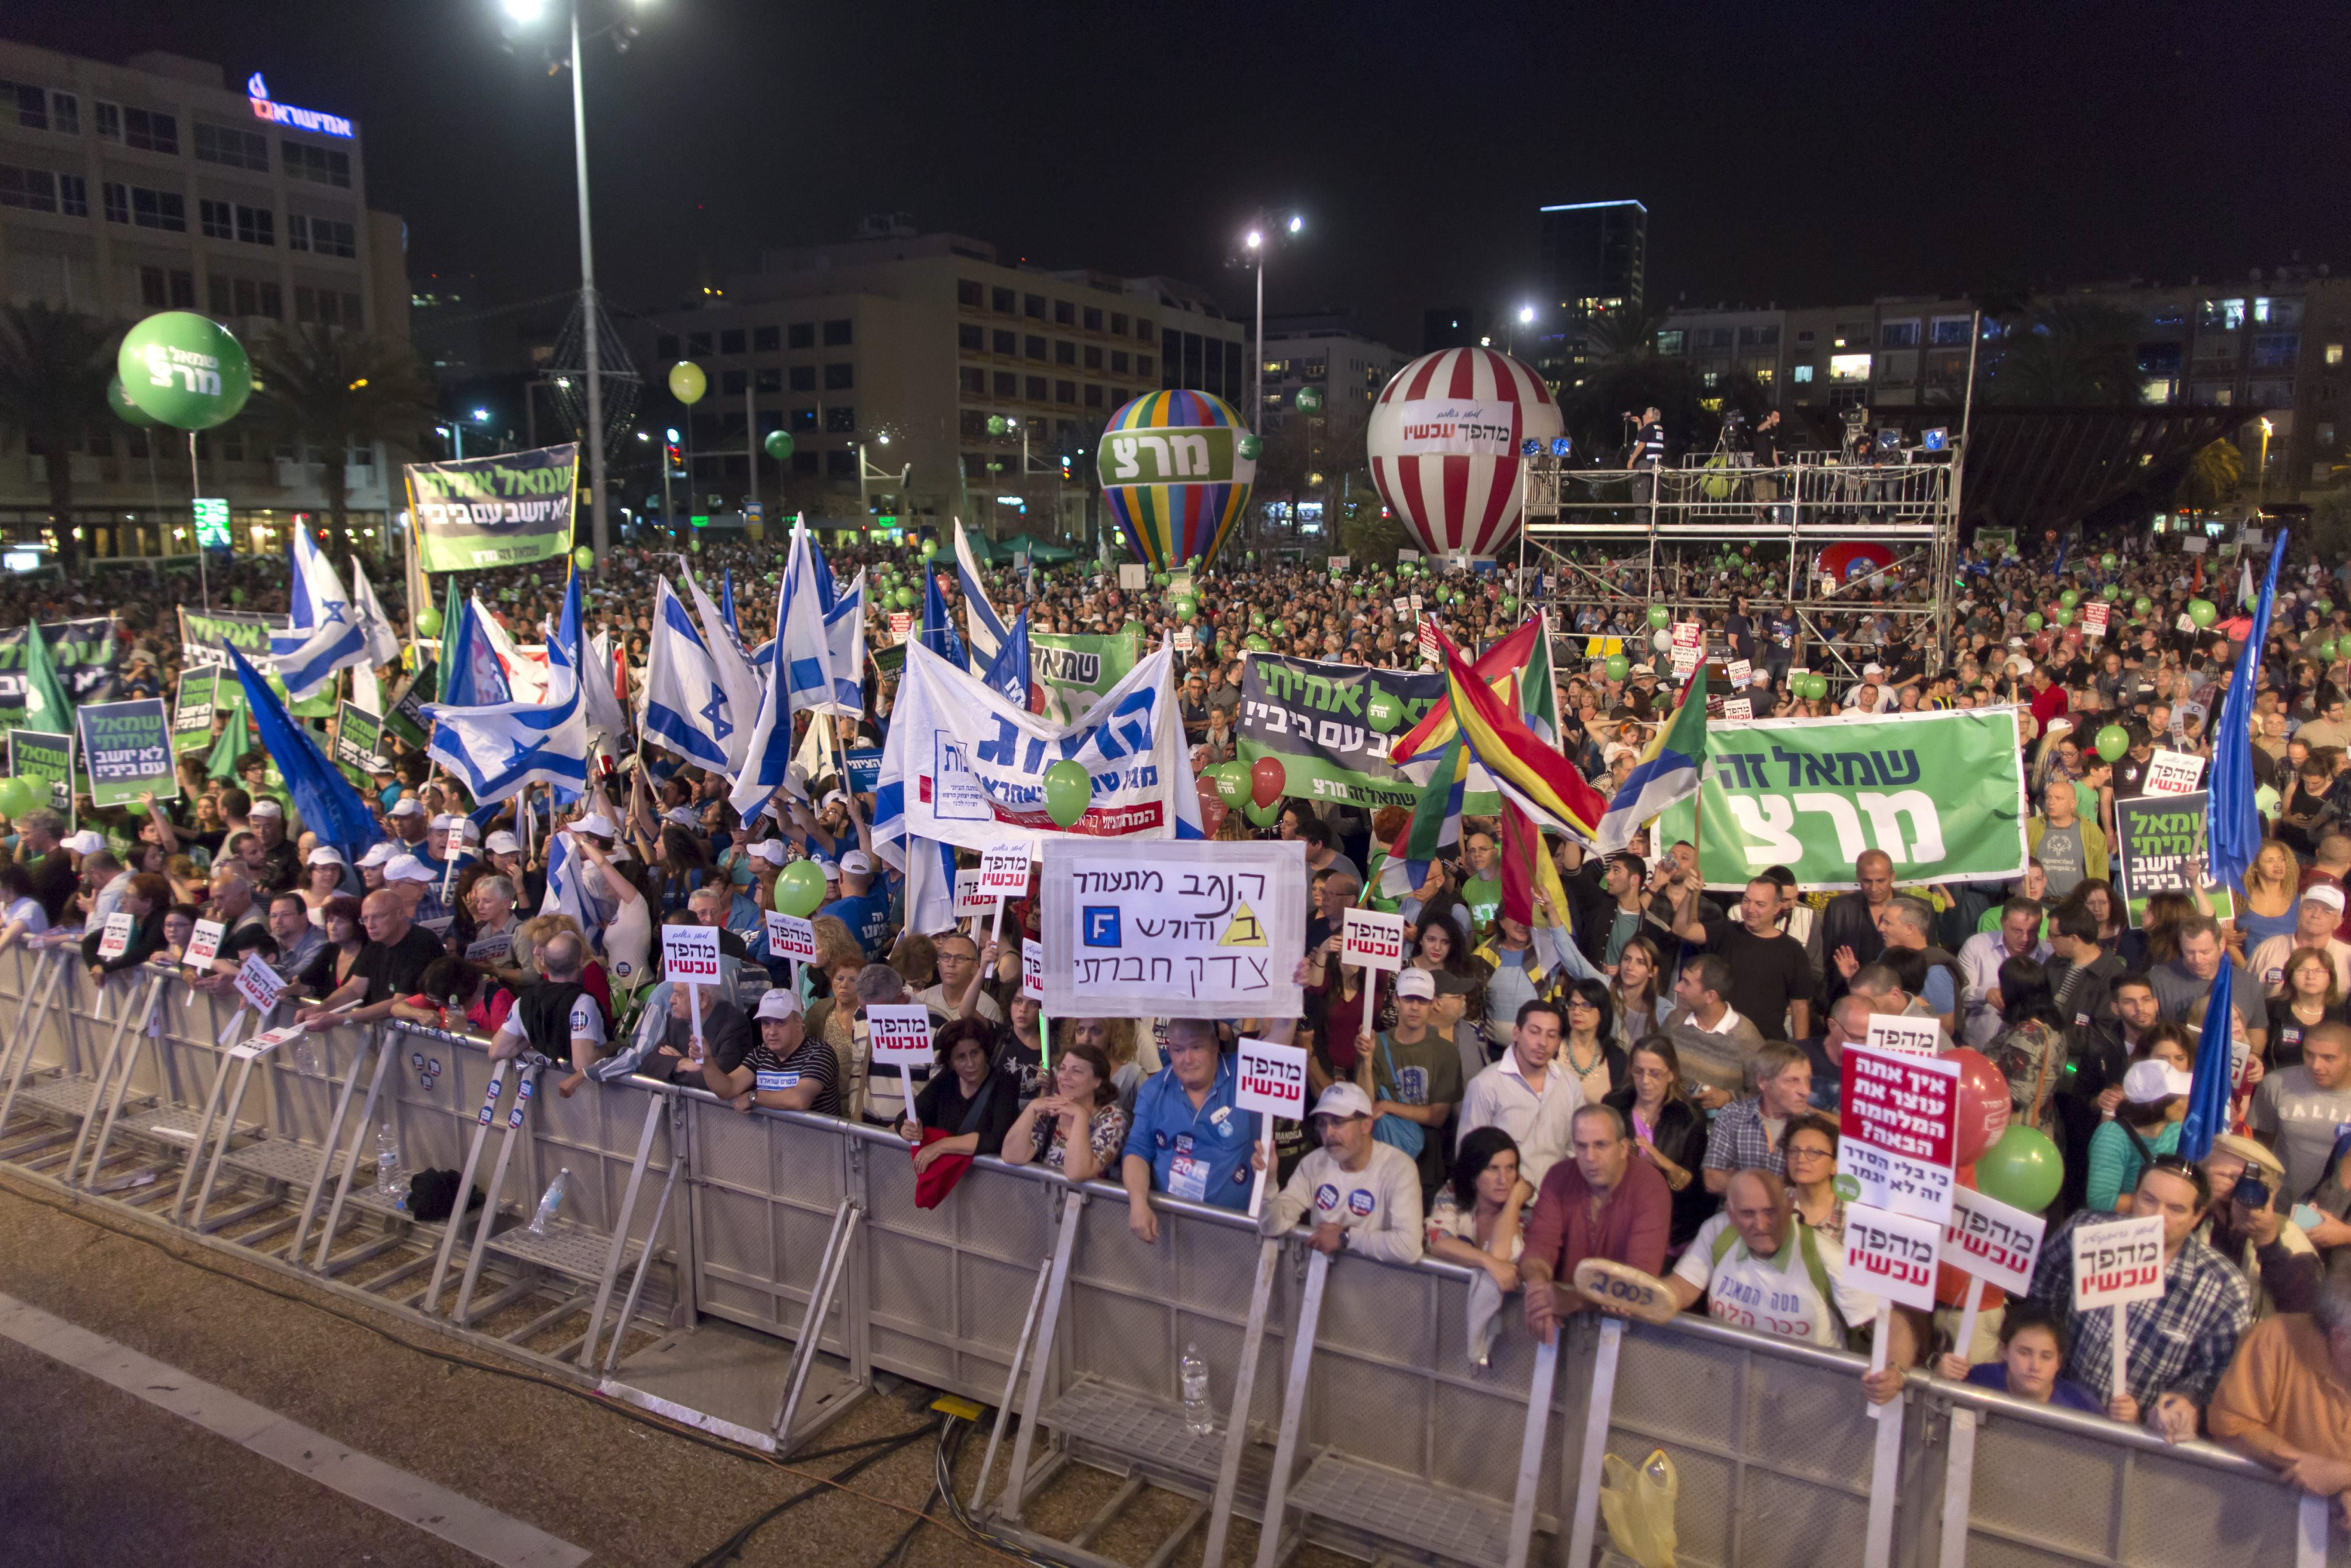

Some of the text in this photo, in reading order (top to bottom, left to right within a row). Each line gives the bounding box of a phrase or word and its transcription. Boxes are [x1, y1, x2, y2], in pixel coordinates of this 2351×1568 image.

[1404, 423, 1510, 442] מהפך עכשיו
[1112, 434, 1210, 478] מרצ
[494, 464, 573, 496] שמאל
[470, 502, 504, 525] עם
[505, 501, 550, 522] יושב
[1257, 661, 1364, 717] אמיתי
[1244, 701, 1314, 742] ביבי!
[1726, 706, 1749, 715] מהפך
[91, 715, 161, 733] שמאל
[1318, 720, 1364, 752] עם
[94, 745, 165, 764] לא יושב
[140, 762, 166, 775] עם
[1716, 746, 1921, 789] שמאל זה
[2154, 764, 2197, 782] מהפך
[1218, 786, 1236, 794] מרצ
[1313, 778, 1417, 806] שמאל זה מרצ
[2148, 777, 2193, 794] עכשיו
[1728, 789, 1946, 865] מרצ
[984, 856, 1028, 872] מהפך
[2132, 855, 2182, 872] יושב
[982, 872, 1026, 887] עכשיו
[2132, 872, 2217, 891] ע ביבי!
[1178, 873, 1265, 919] הנגב
[195, 929, 219, 945] מהפך
[769, 923, 812, 943] מהפך
[1135, 918, 1215, 941] ודורש
[1347, 921, 1400, 942] מהפך
[189, 942, 215, 958] עכשיו
[666, 942, 716, 960] מהפך
[773, 937, 813, 956] עכשיו
[1347, 938, 1399, 957] עכשיו
[668, 959, 717, 975] עכשיו
[1024, 956, 1041, 975] פך
[1074, 955, 1270, 999] צדק חברתי
[239, 974, 273, 1008] עכשיו
[247, 964, 277, 1000] מהפך
[1026, 973, 1043, 991] שיו
[871, 1018, 926, 1035] מהפך
[874, 1036, 929, 1050] עכשיו
[1872, 1028, 1934, 1049] מהפך
[1242, 1054, 1301, 1081] מהפך
[1855, 1056, 1946, 1096] איך אתה
[1242, 1076, 1301, 1101] עכשיו
[1854, 1077, 1946, 1115] עוצר את
[1852, 1099, 1946, 1139] המלחמה
[1275, 1129, 1303, 1140] MANDELA
[1861, 1120, 1933, 1158] הבאה?
[1844, 1144, 1949, 1187] כי בלי הסדר
[1849, 1163, 1941, 1202] זה לא יגמר
[1954, 1204, 2034, 1253] מהפך
[1850, 1222, 1933, 1263] מהפך
[1946, 1226, 2029, 1275] עכשיו
[1848, 1247, 1930, 1287] עכשיו
[2080, 1241, 2158, 1274] מהפך
[1589, 1271, 1654, 1306] 2003
[2081, 1265, 2157, 1295] עכשיו
